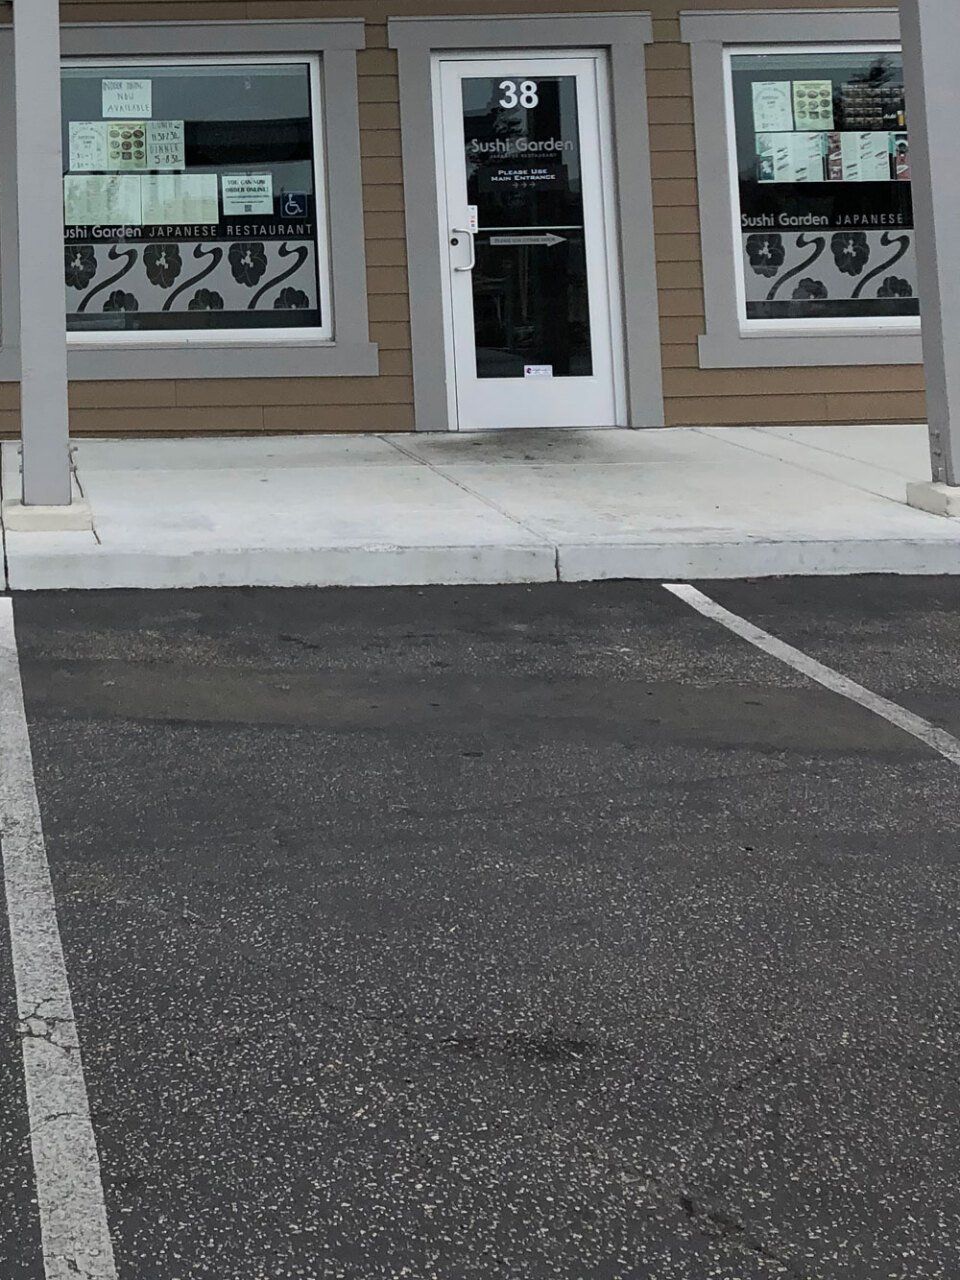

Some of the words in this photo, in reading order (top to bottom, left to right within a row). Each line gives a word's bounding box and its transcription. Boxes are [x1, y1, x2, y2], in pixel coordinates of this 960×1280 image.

[499, 80, 539, 109] 38
[471, 138, 510, 152] Sushi
[515, 137, 574, 152] Garden
[741, 213, 774, 226] Sushi
[779, 212, 829, 226] Garden
[835, 213, 904, 225] JAPANESE
[64, 225, 88, 239] ushi
[92, 225, 141, 238] Garden
[149, 225, 217, 237] JAPANESE
[227, 224, 313, 236] RESTAURANT
